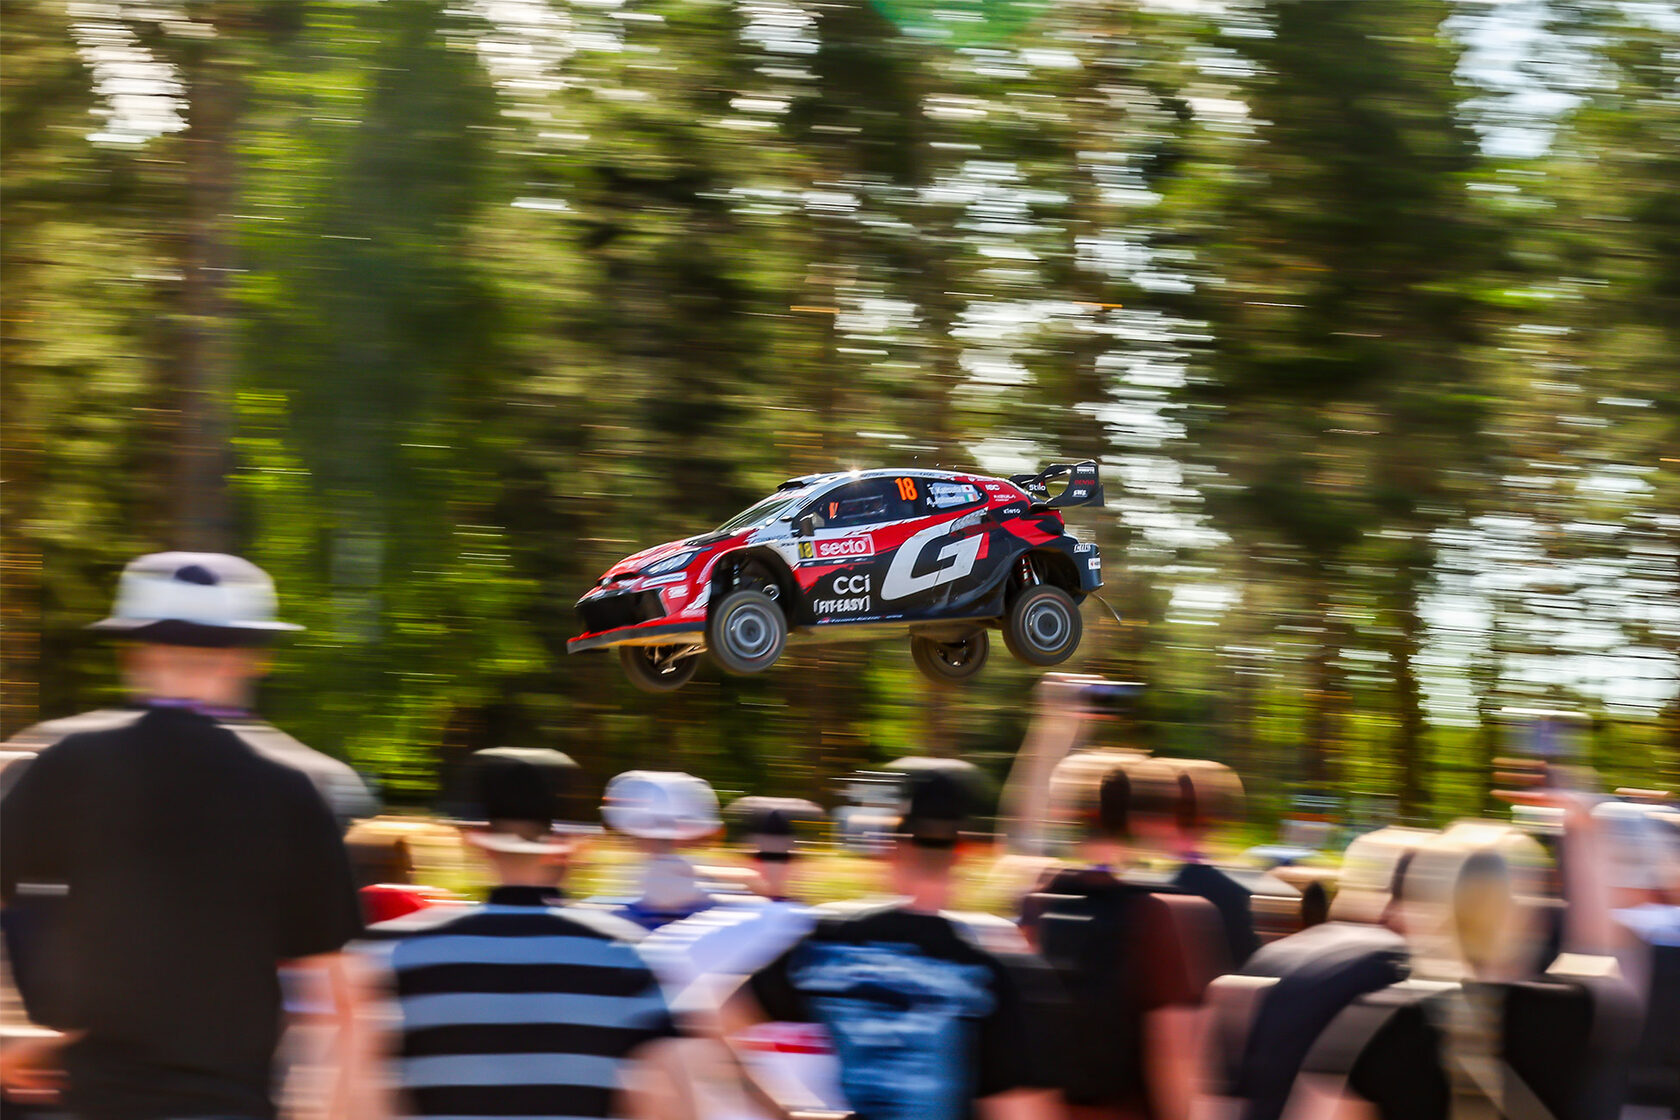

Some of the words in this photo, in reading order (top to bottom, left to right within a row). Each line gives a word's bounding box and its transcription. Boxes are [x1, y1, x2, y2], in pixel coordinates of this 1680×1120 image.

[895, 477, 918, 501] 18
[798, 542, 814, 558] 18
[819, 538, 867, 556] secto
[881, 518, 984, 601] G
